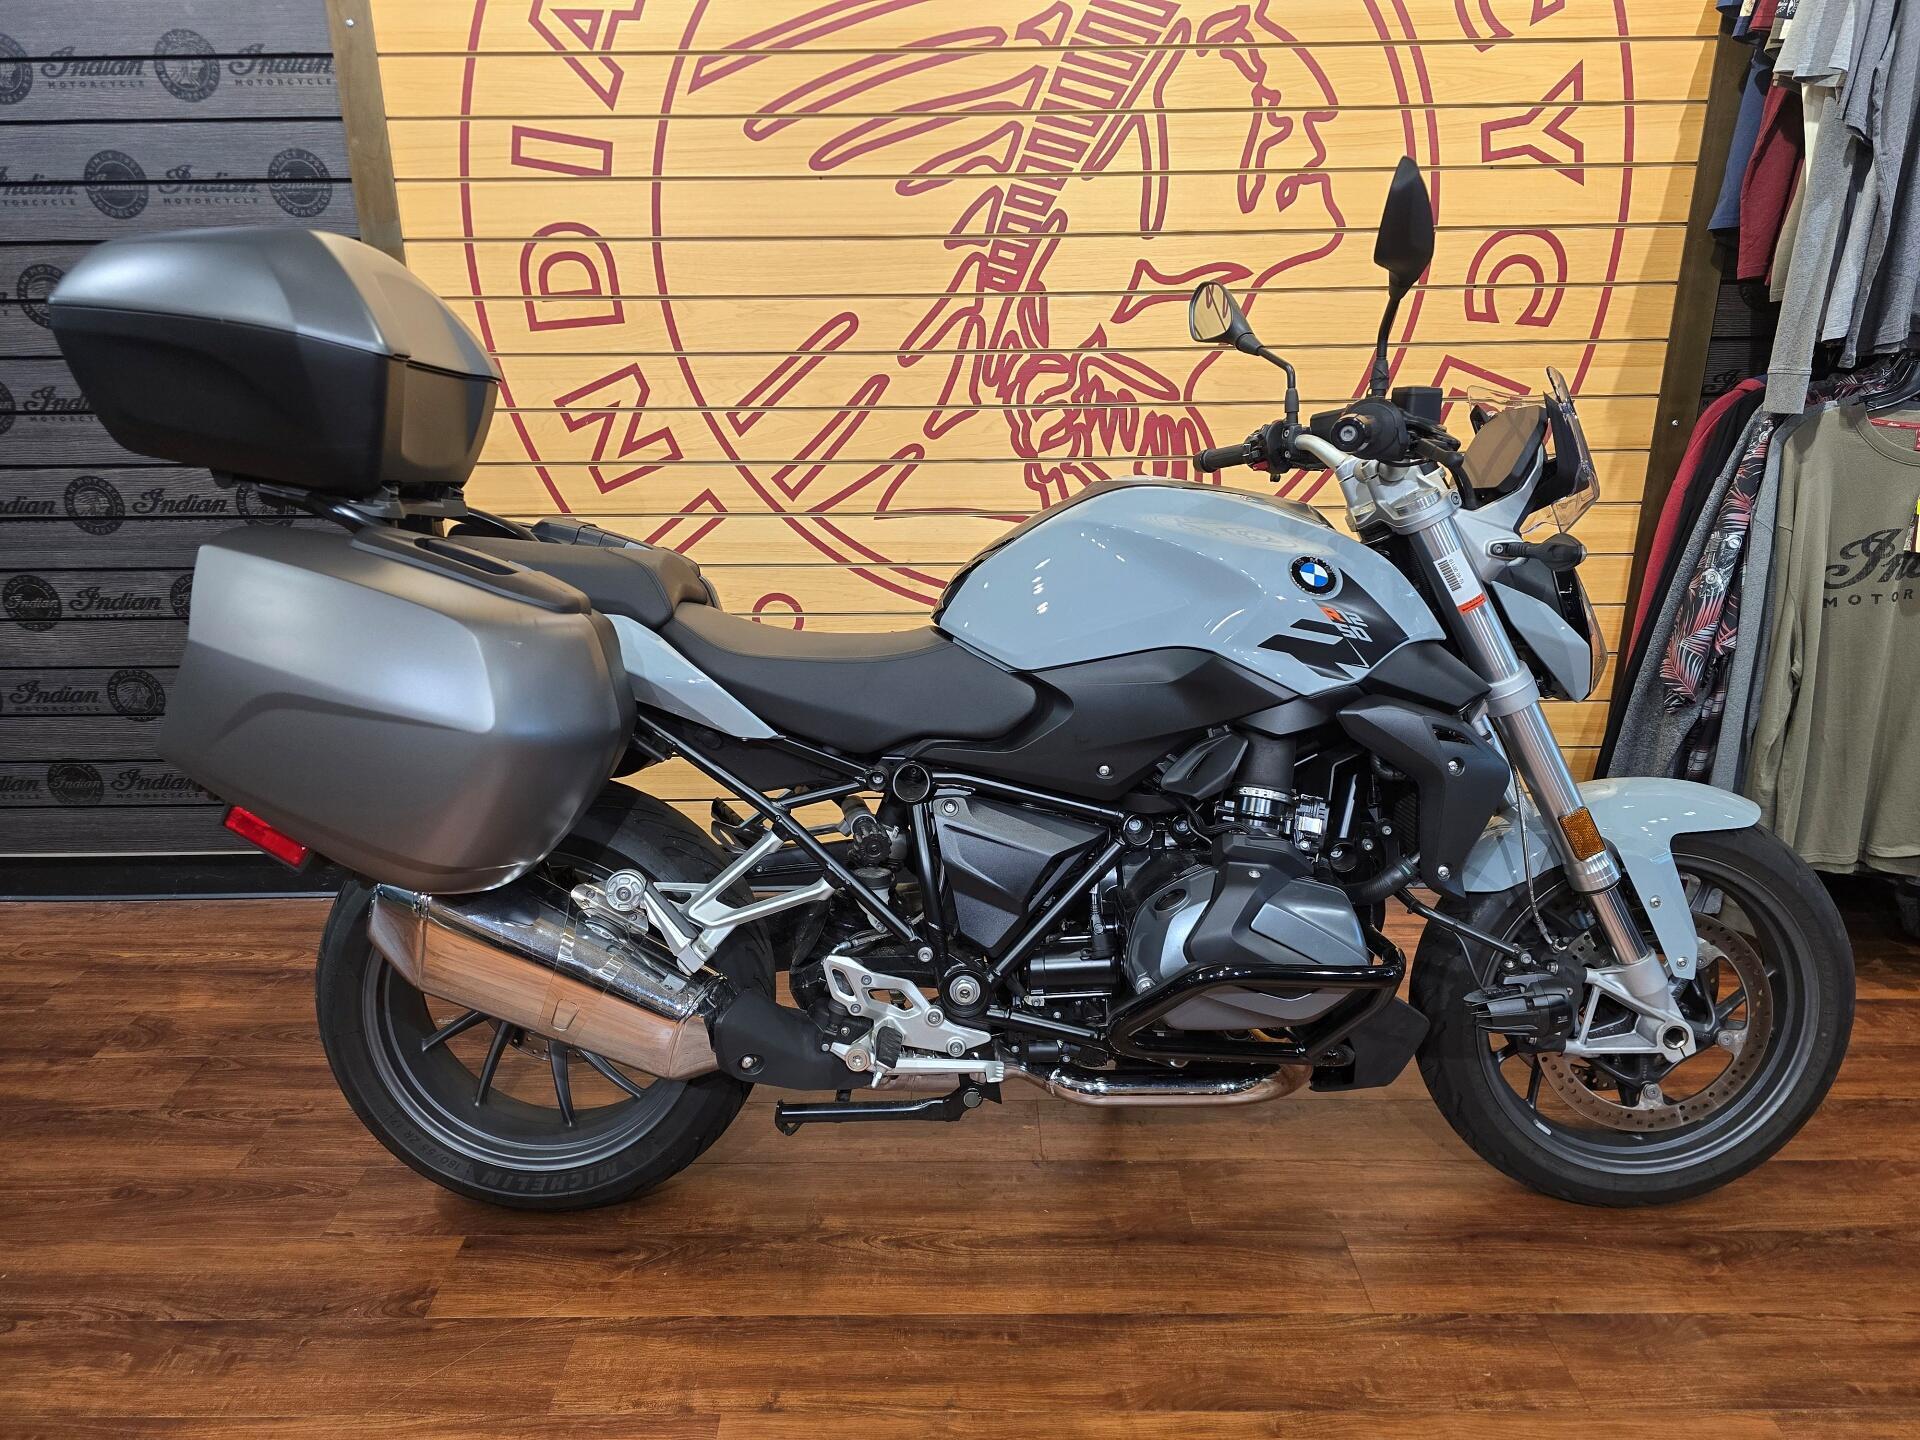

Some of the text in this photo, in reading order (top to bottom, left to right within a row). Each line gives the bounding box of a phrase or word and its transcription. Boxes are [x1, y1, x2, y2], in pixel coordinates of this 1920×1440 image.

[41, 46, 146, 77] Indian
[228, 43, 333, 75] Indian
[48, 80, 145, 89] MOTORCYCLE
[235, 78, 332, 86] MOTORCYCLE
[158, 165, 260, 194] Indian
[132, 488, 228, 514] Indian
[69, 587, 163, 612] Indian
[1823, 589, 1914, 609] MOTOR
[9, 680, 99, 704] Indian
[480, 1161, 617, 1191] MICHELIN
